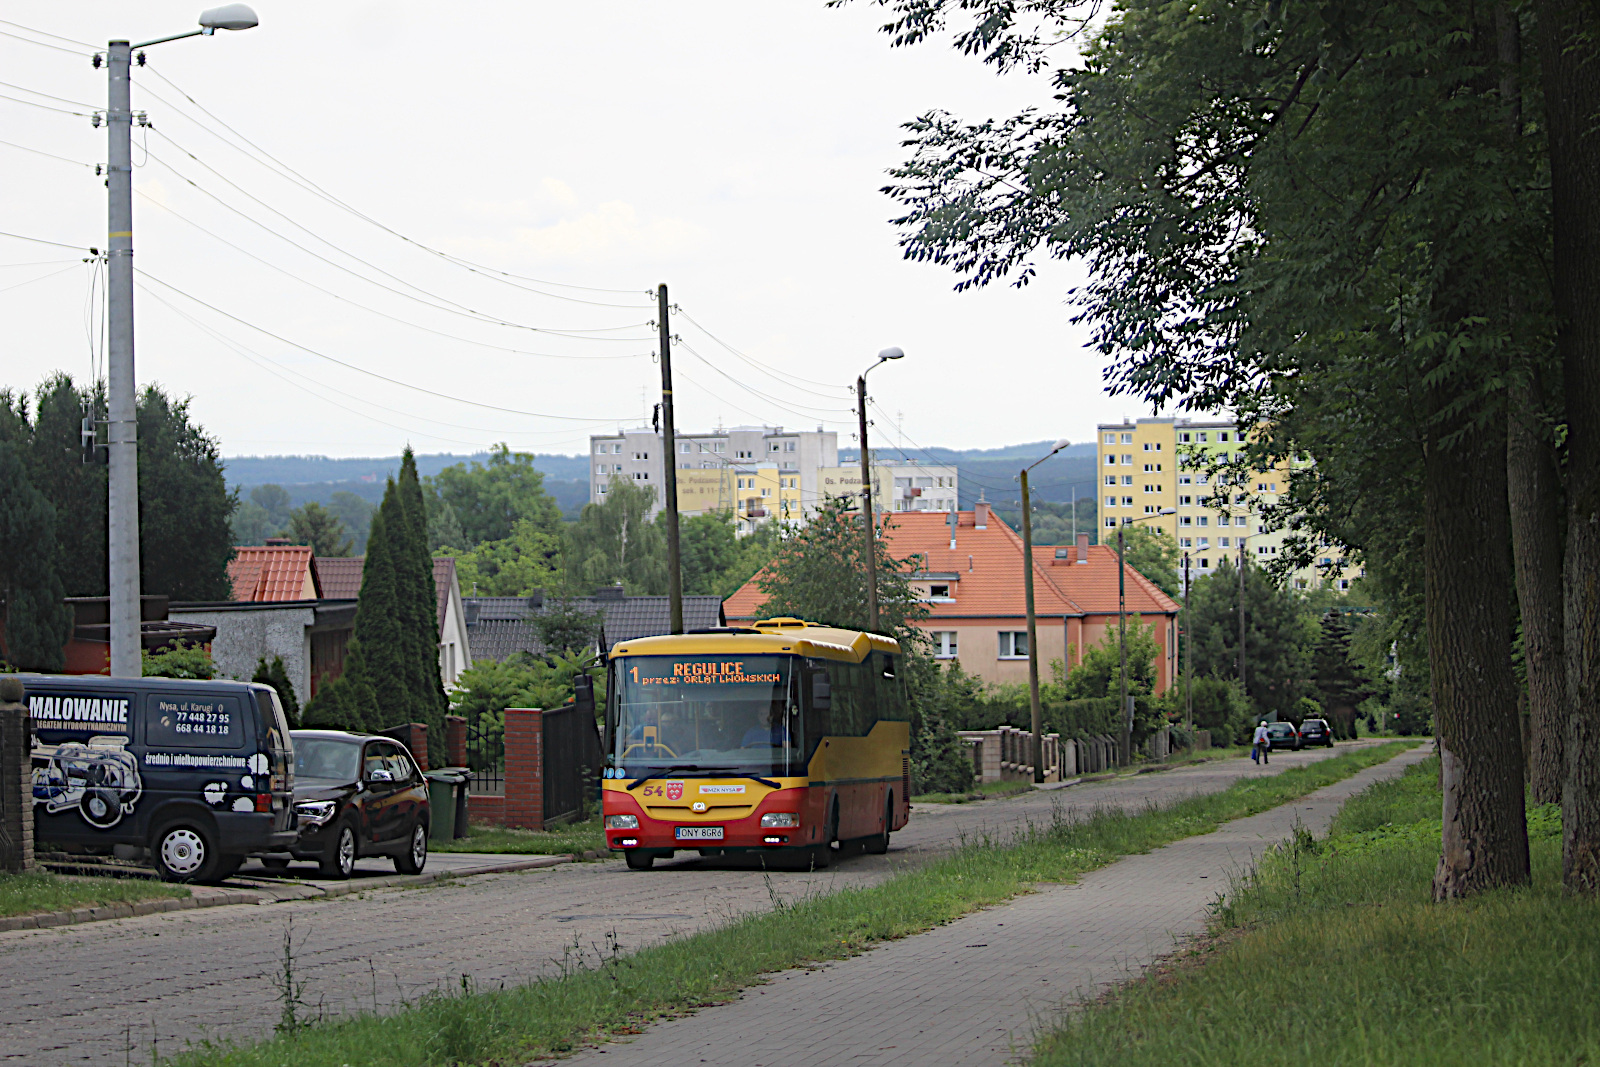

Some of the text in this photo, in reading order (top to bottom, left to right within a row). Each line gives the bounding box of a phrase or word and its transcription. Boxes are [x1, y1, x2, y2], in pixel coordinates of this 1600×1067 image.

[629, 666, 638, 683] 1
[673, 662, 744, 676] REGULICE
[642, 677, 680, 685] przez:
[29, 696, 129, 722] MALOWANIE
[159, 701, 179, 712] Nysa,
[180, 702, 189, 711] ul.
[177, 711, 230, 723] 77 448 27 95
[175, 723, 229, 735] 668 44 18 18
[145, 752, 170, 765] średnio
[174, 754, 246, 767] wielkopowierzchniowe
[643, 785, 664, 796] 54
[681, 828, 722, 837] ONY 8GR6
